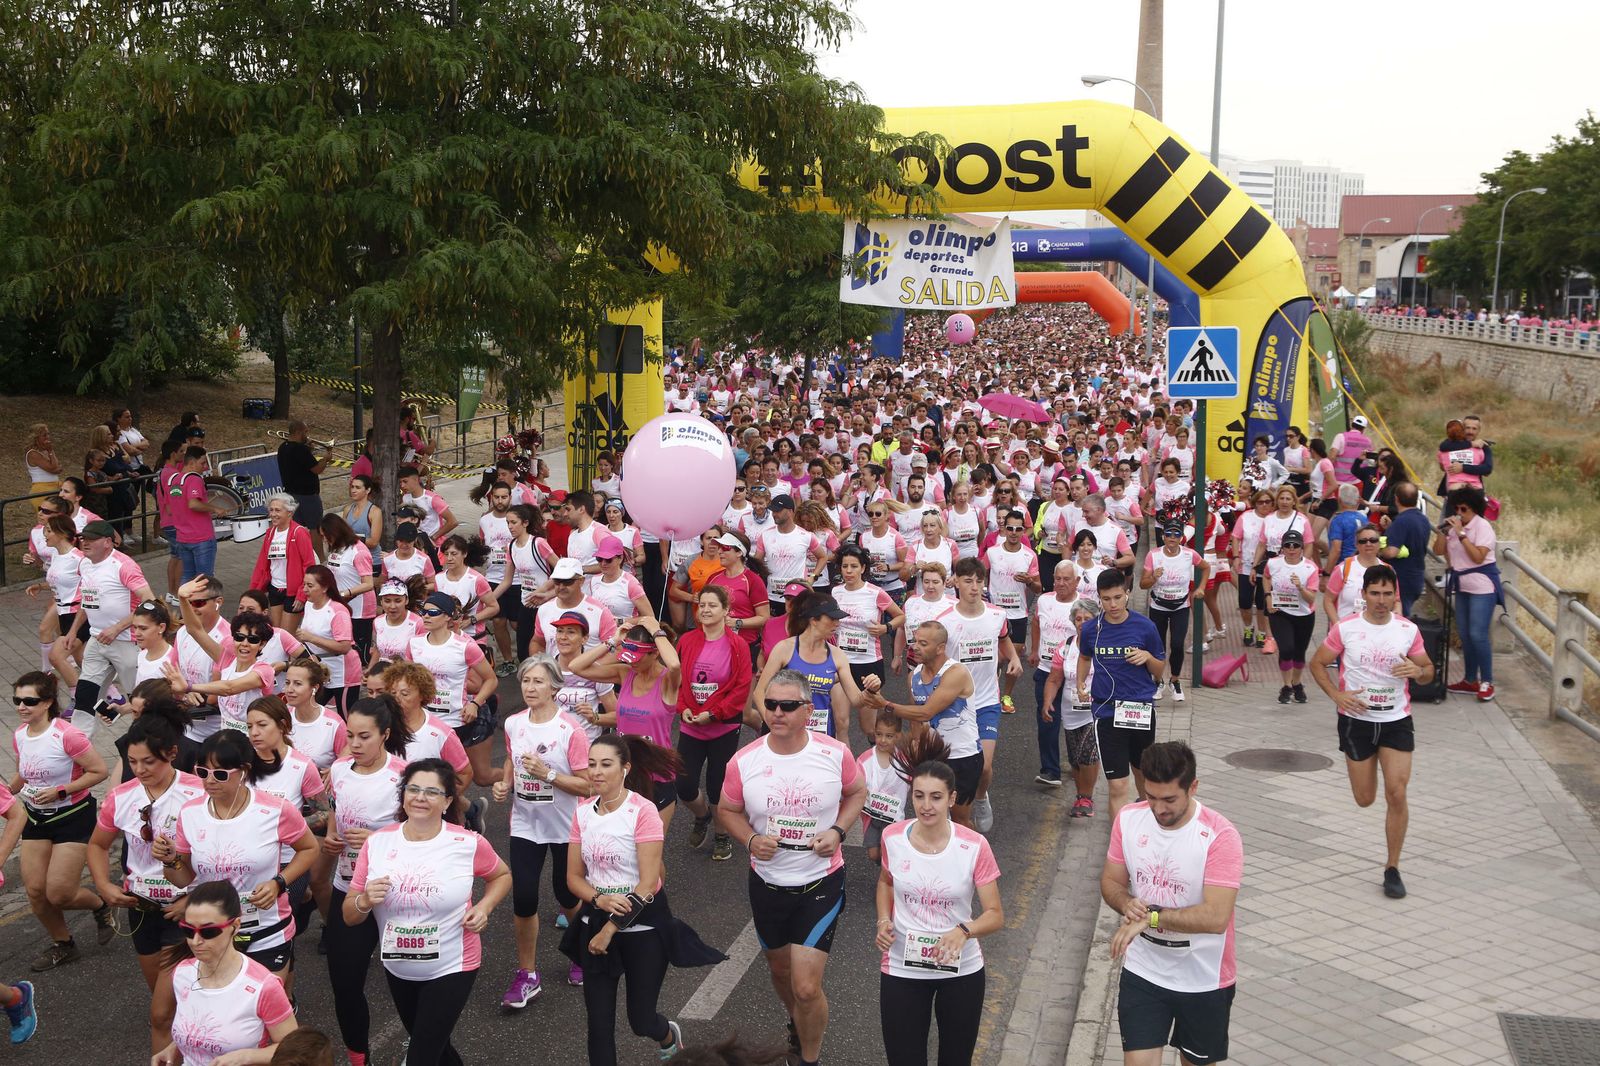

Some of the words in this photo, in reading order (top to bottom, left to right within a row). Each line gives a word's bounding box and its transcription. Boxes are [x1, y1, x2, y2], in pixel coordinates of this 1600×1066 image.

[908, 223, 997, 257] olimpo
[904, 248, 965, 263] deportes
[930, 265, 974, 277] Granada
[899, 275, 1010, 306] SALIDA
[1255, 334, 1278, 396] olimpo
[1268, 361, 1282, 400] deportes
[678, 426, 722, 446] olimpo
[805, 673, 833, 686] limpo
[523, 782, 540, 792] 7379
[870, 799, 889, 812] 9024
[780, 828, 803, 840] 9357
[148, 888, 172, 899] 7886
[396, 937, 425, 949] 8689
